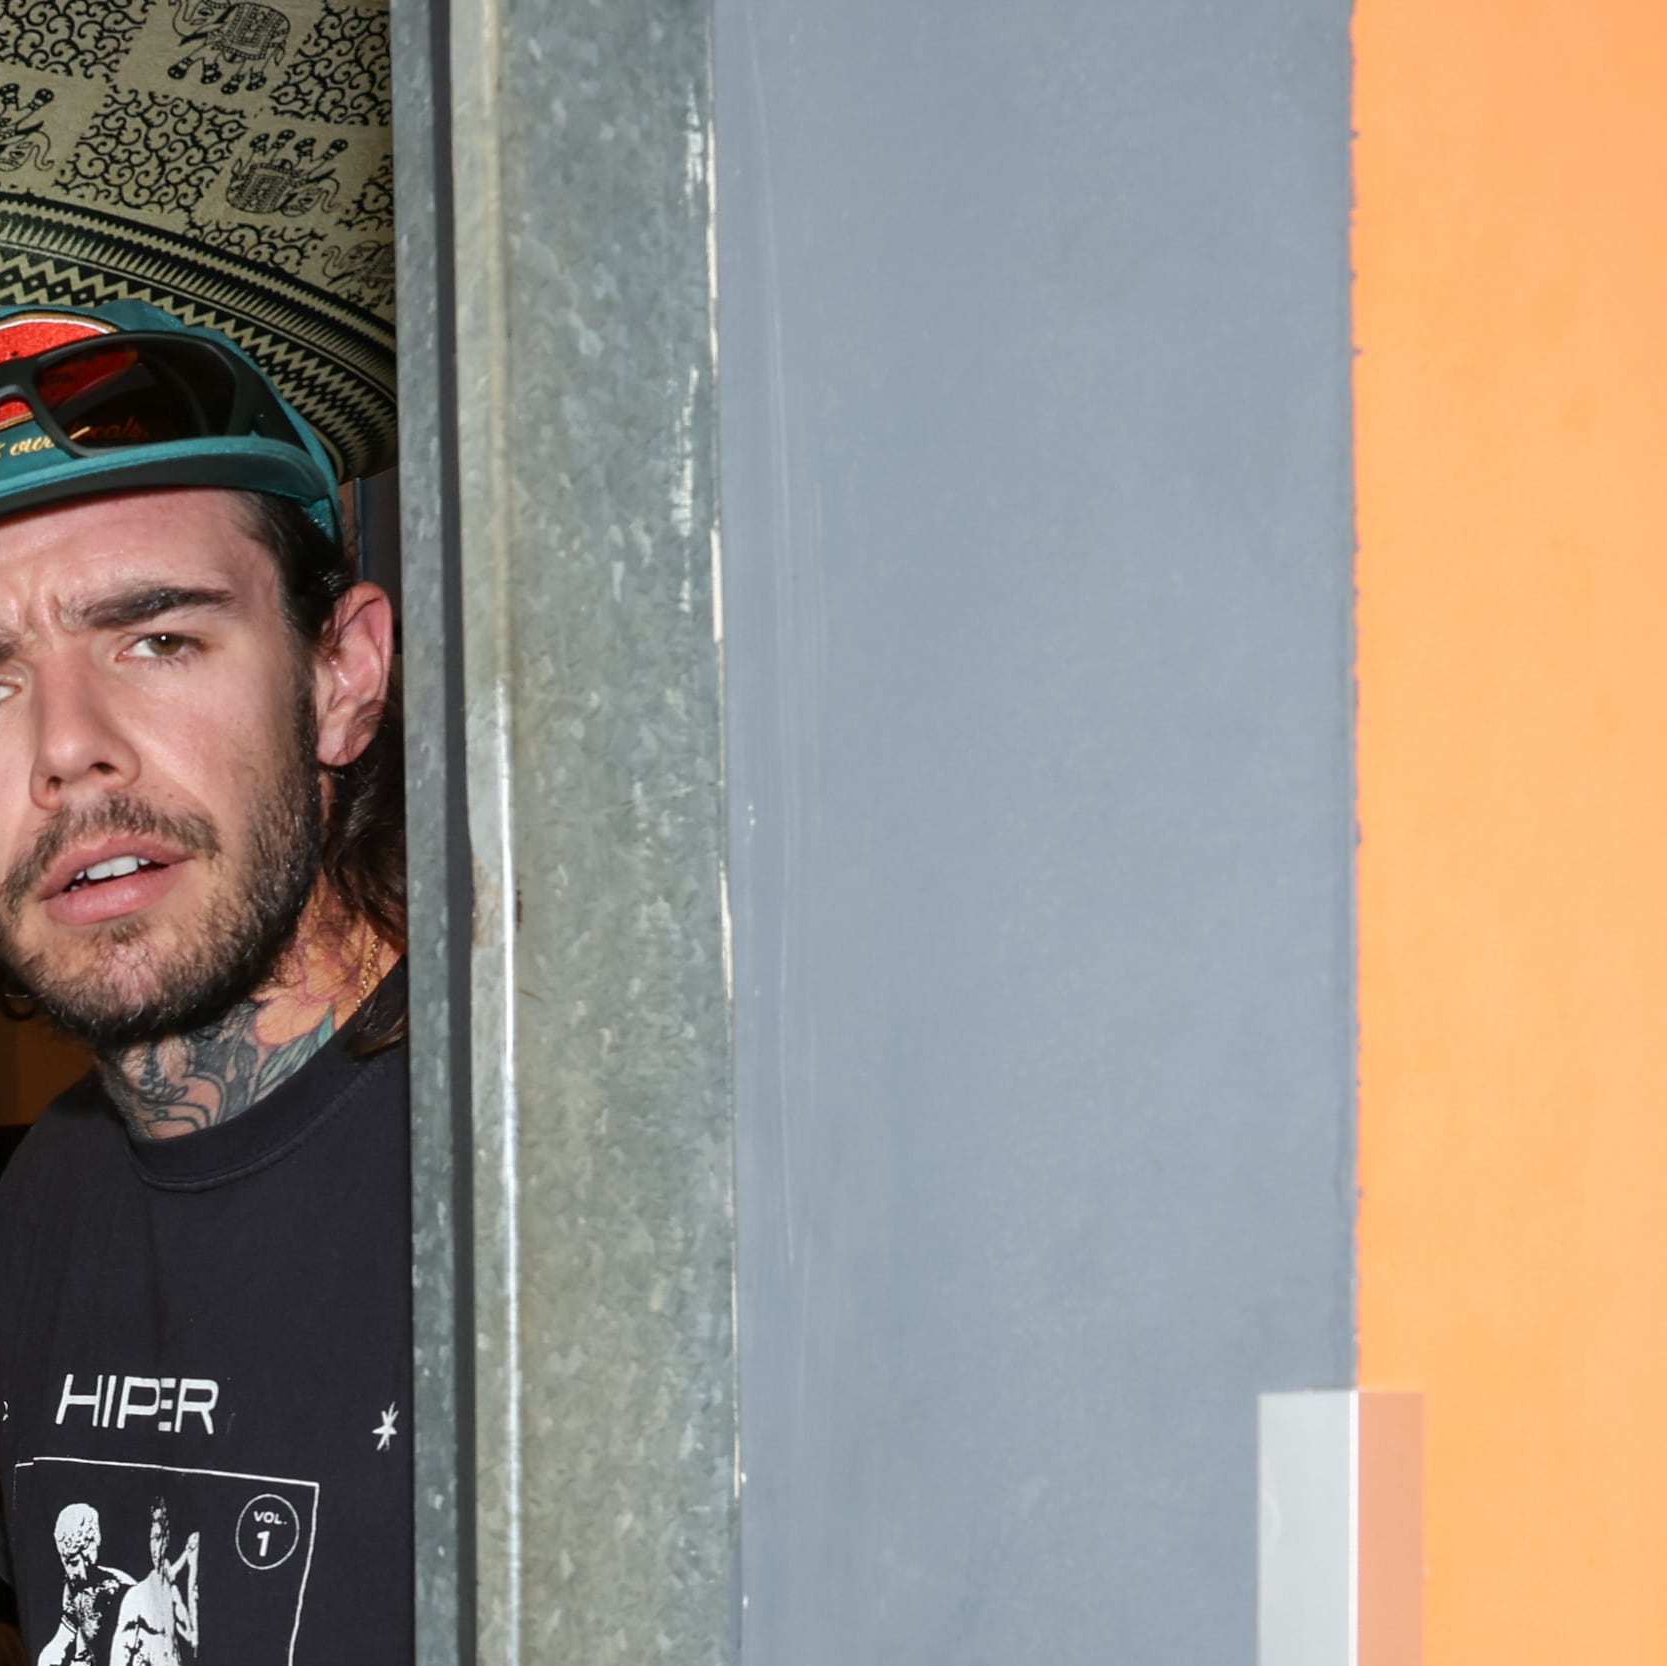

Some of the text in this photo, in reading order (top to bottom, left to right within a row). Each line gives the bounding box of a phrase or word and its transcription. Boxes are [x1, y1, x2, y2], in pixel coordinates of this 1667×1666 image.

[55, 1373, 219, 1435] HIPER
[253, 1510, 288, 1526] VOL.
[257, 1530, 270, 1557] 1
